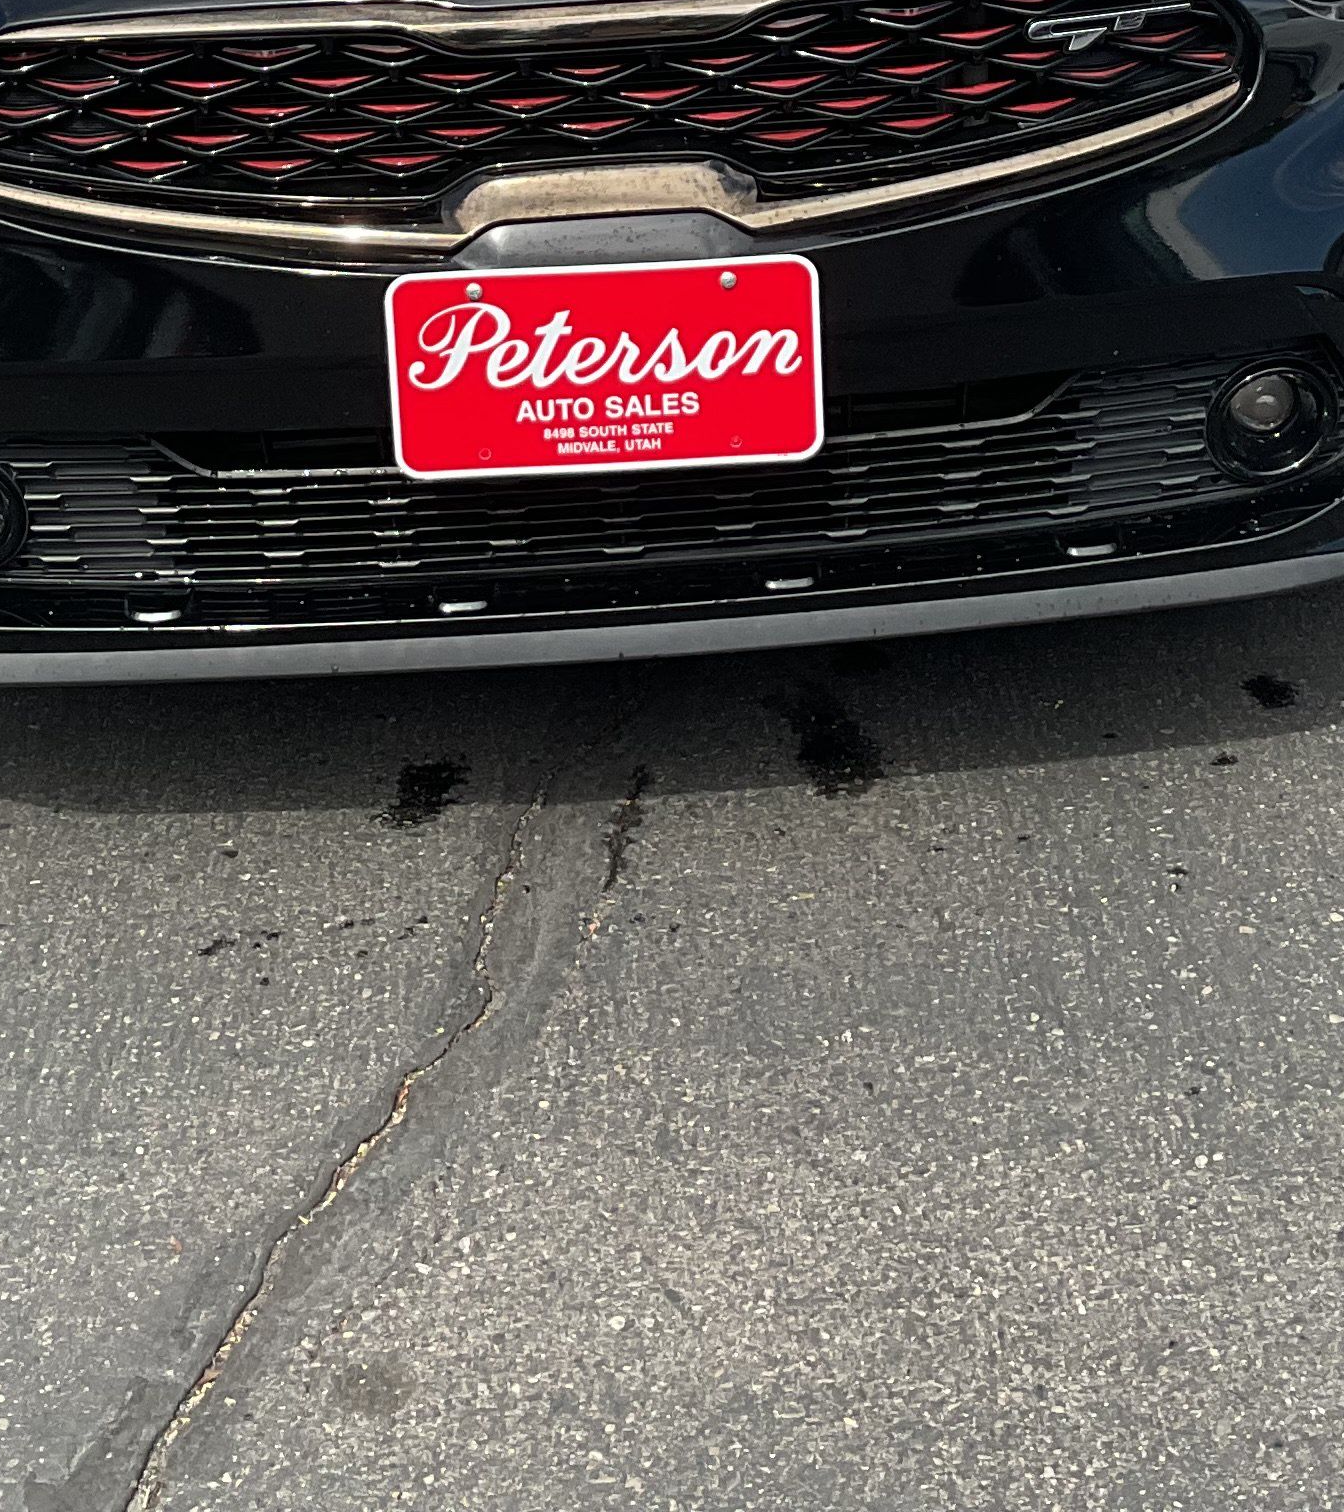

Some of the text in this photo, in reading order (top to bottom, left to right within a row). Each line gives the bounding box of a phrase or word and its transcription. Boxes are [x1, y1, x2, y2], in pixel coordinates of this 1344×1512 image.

[408, 302, 803, 389] Peterson
[516, 391, 701, 423] AUTO SALES
[543, 421, 674, 439] 8498 SOUTH STATE
[557, 437, 662, 454] MIDVALE, UTAH
